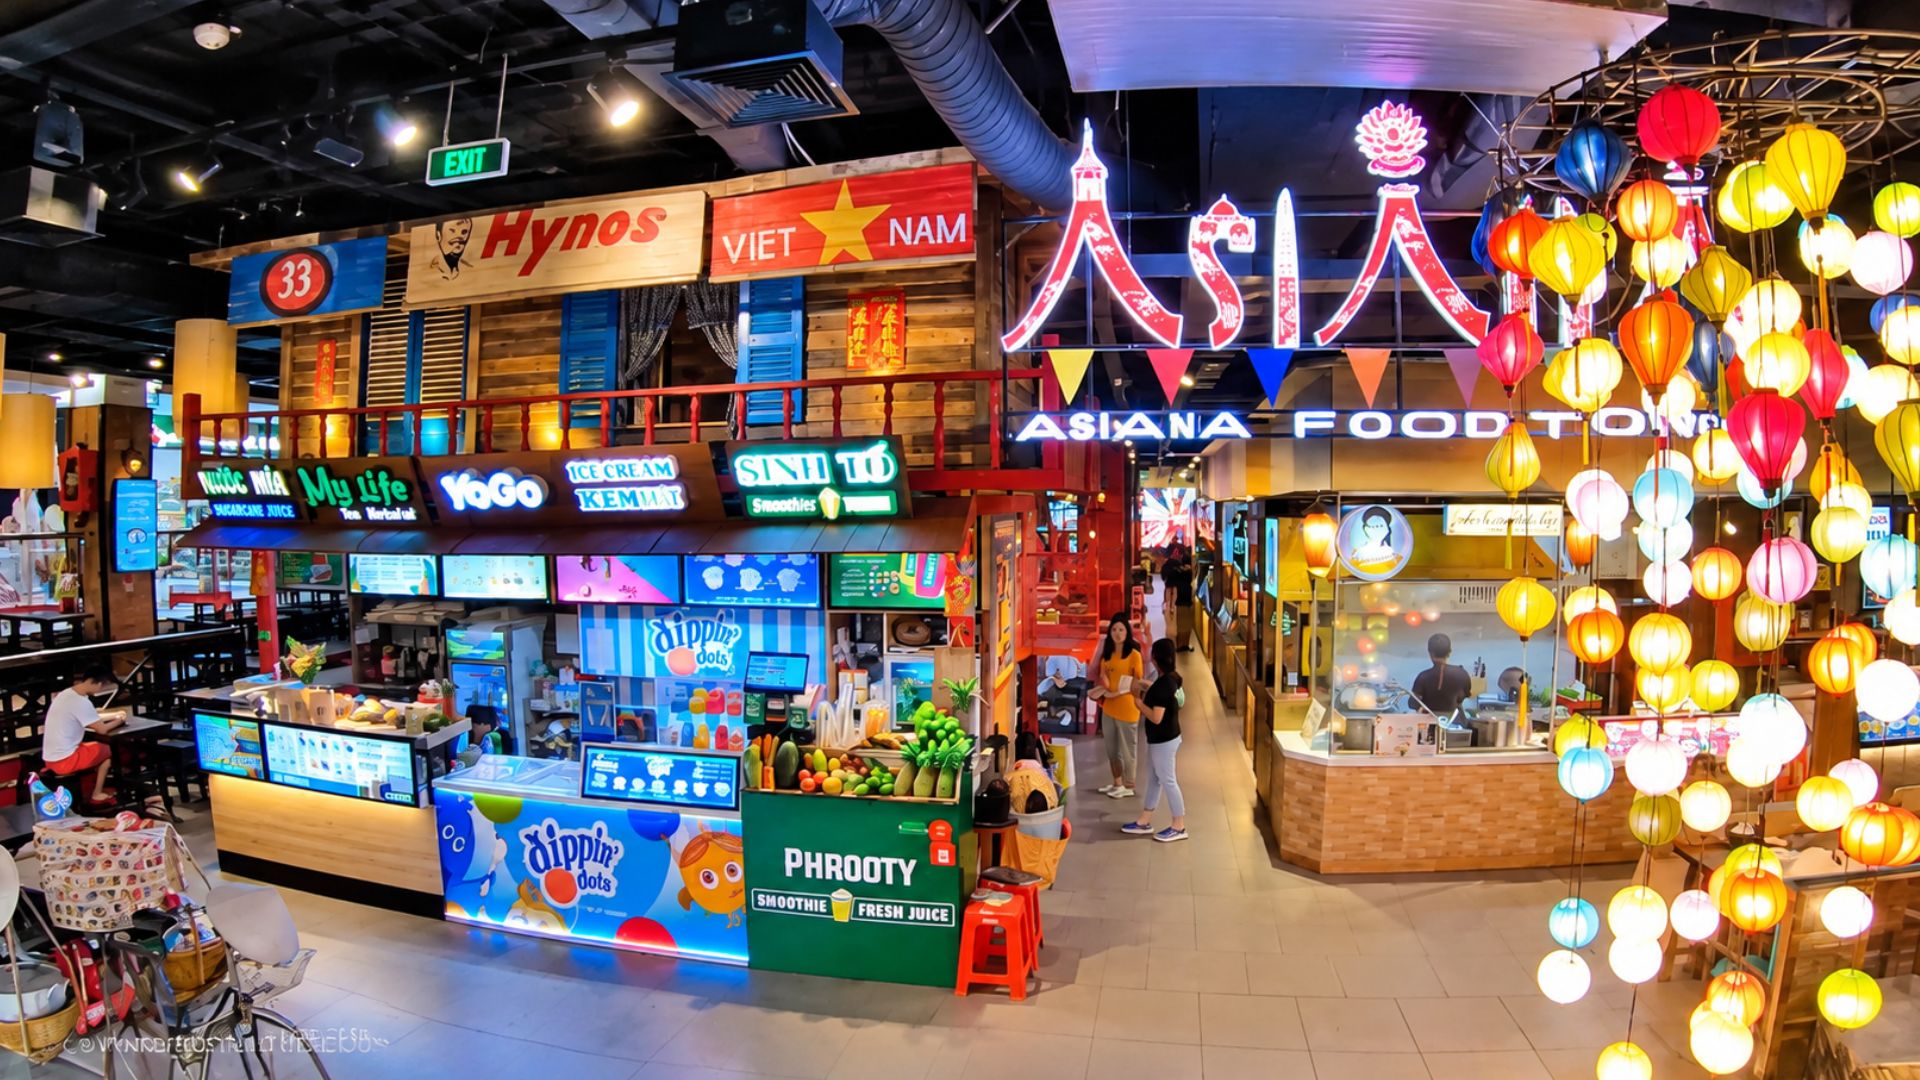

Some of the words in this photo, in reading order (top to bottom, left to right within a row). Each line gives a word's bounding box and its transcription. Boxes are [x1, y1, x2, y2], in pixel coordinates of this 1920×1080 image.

[444, 147, 487, 177] EXIT
[480, 206, 668, 277] Hynos
[722, 227, 797, 265] VIET
[888, 213, 967, 248] NAM
[277, 258, 312, 299] 33
[1015, 411, 1253, 441] ASIANA
[567, 463, 601, 483] ICE
[603, 461, 675, 481] CREAM
[736, 453, 830, 485] SINH
[296, 466, 353, 508] My
[356, 469, 409, 506] Life
[751, 498, 818, 513] Smoothies
[696, 647, 729, 668] dots
[576, 868, 613, 893] dots
[784, 847, 917, 887] PHROOTY
[757, 893, 828, 913] SMOOTHIE
[858, 902, 904, 920] FRESH
[908, 906, 949, 922] JUICE
